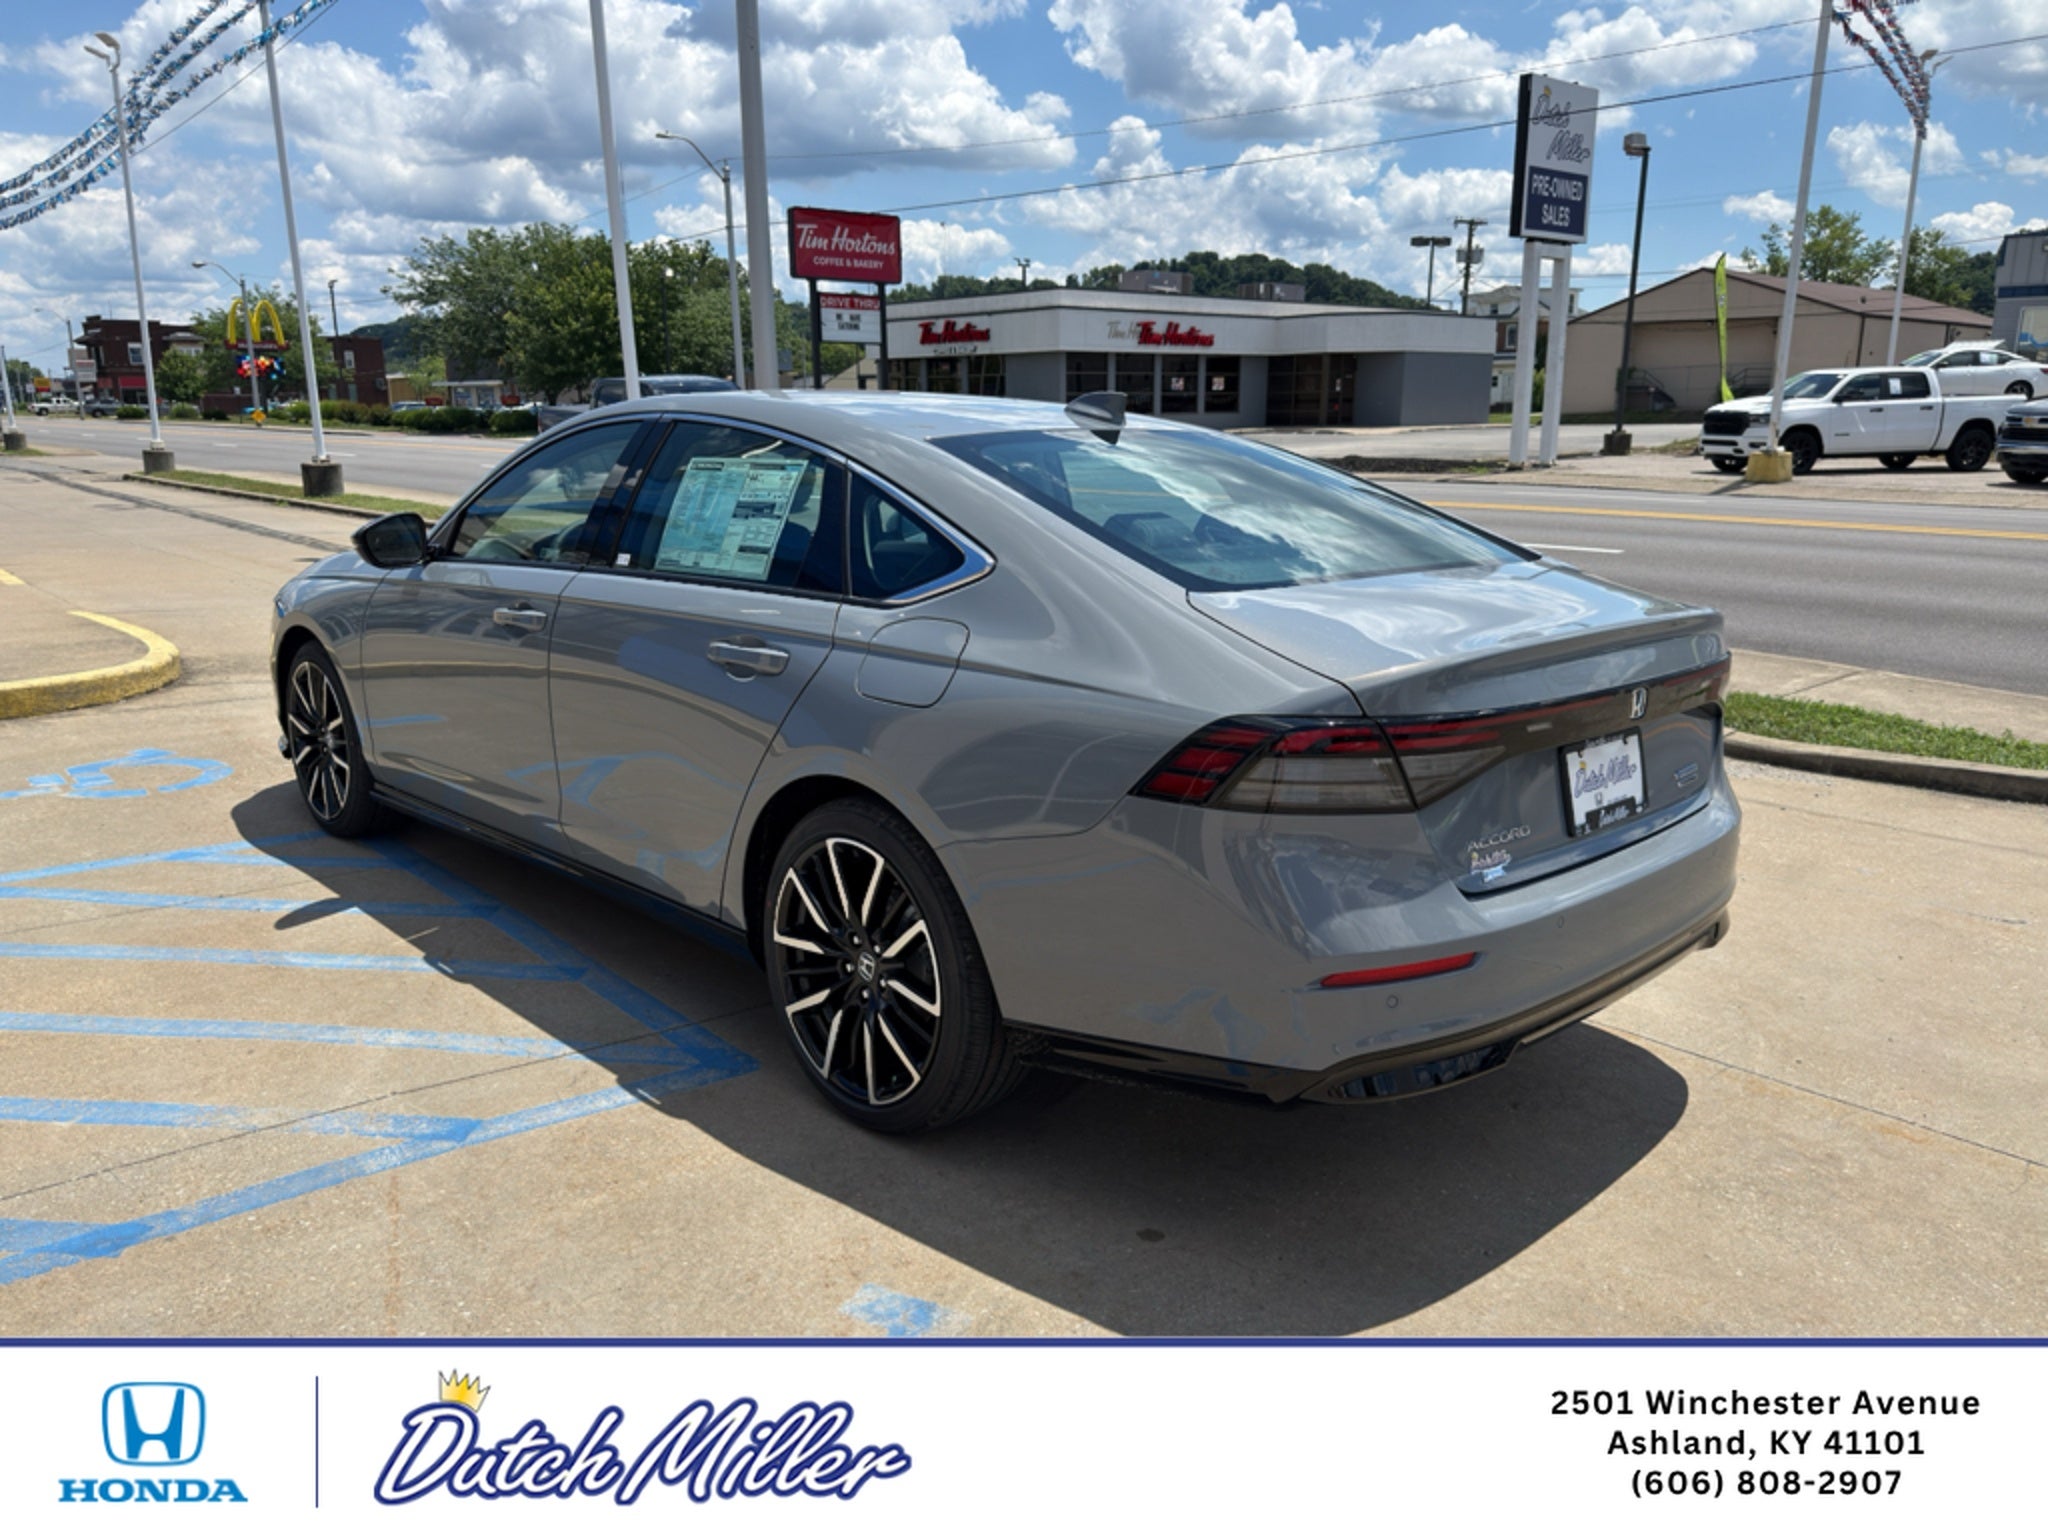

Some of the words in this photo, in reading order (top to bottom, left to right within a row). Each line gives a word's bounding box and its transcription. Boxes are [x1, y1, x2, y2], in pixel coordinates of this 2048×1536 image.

[1531, 174, 1584, 201] PRE-OWNED
[1541, 203, 1571, 227] SALES
[796, 224, 829, 251] Tim
[830, 224, 896, 256] Hortons
[813, 255, 844, 266] COFFEE
[845, 257, 852, 267] &
[853, 259, 884, 271] BAKERY
[819, 295, 850, 309] DRIVE
[853, 297, 881, 310] THRU
[1468, 825, 1531, 851] ACCORD
